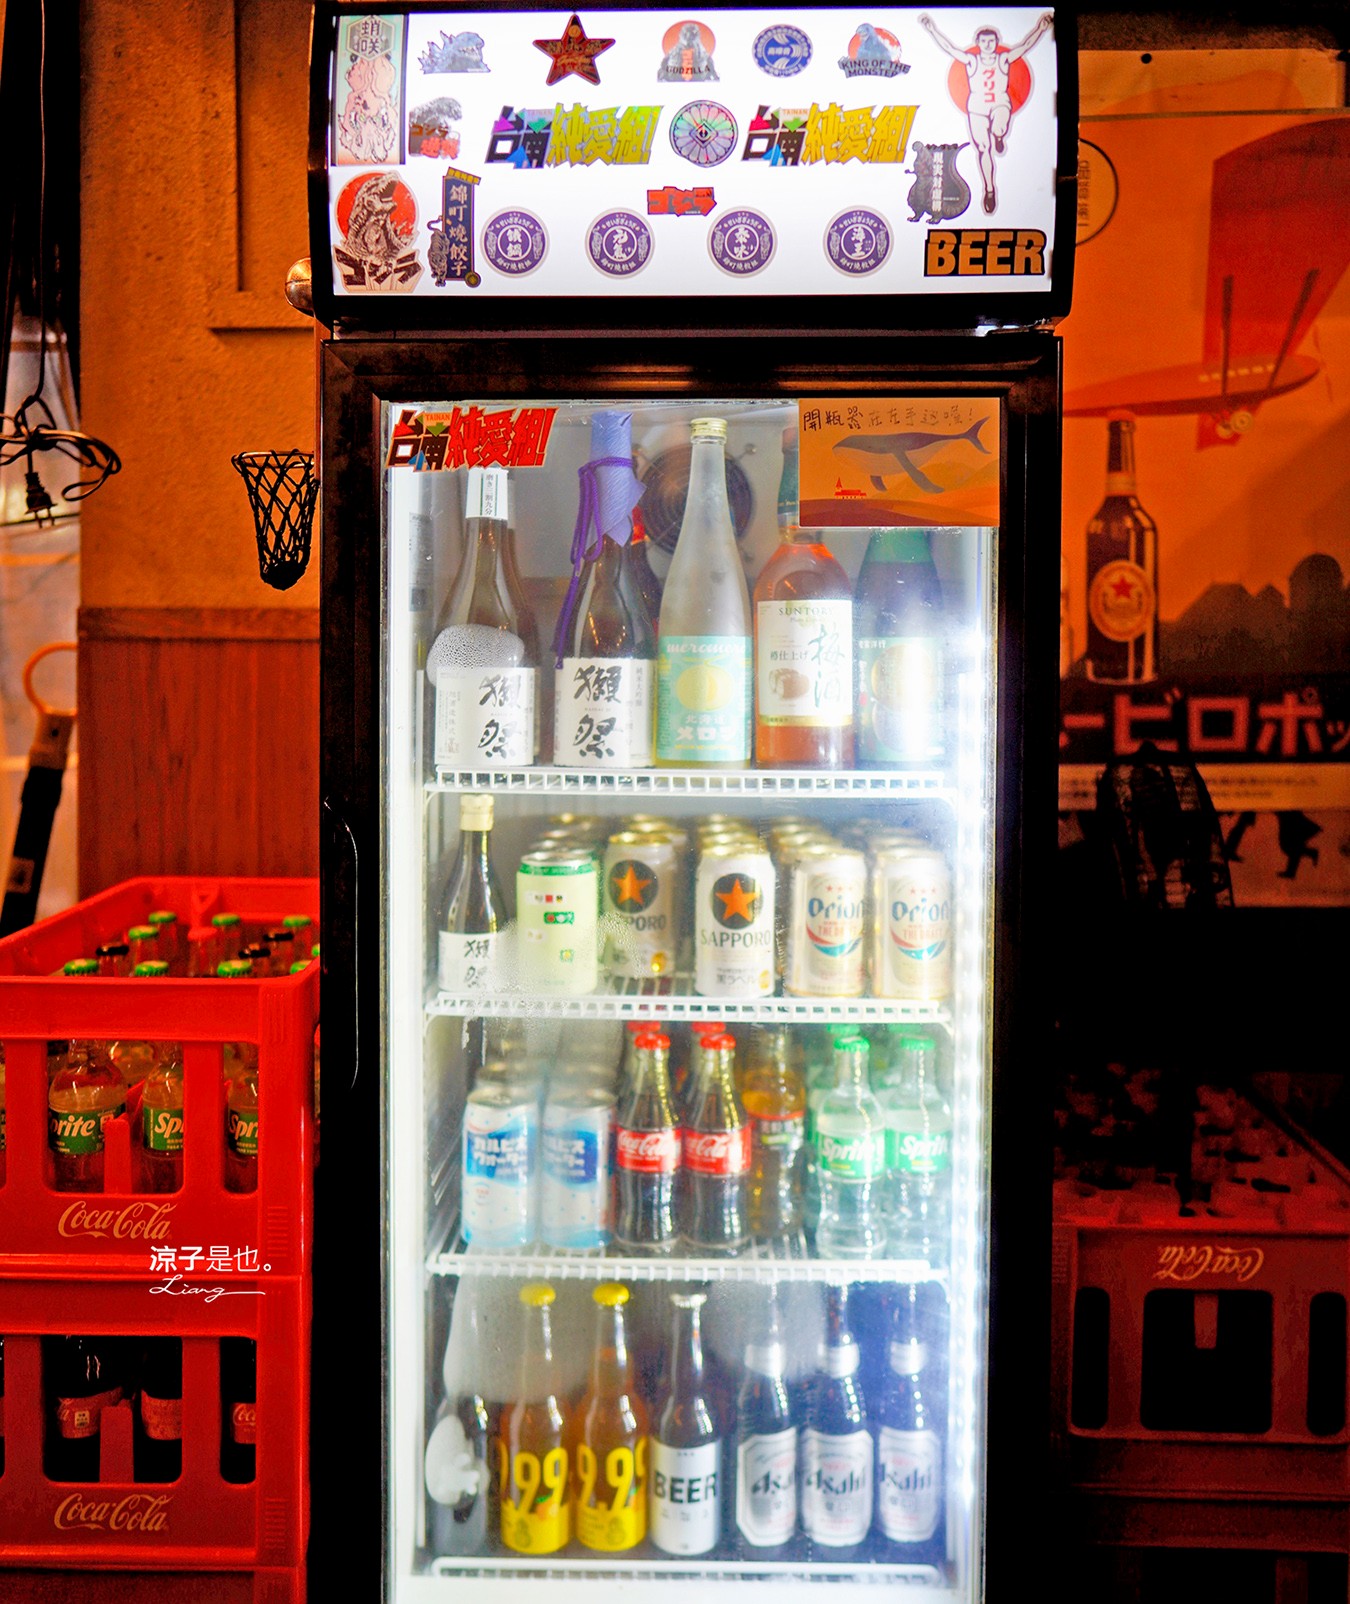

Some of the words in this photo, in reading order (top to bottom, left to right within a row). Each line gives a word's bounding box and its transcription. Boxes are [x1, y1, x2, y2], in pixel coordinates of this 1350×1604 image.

[665, 65, 711, 75] GODZILLA
[871, 59, 885, 68] OF
[982, 68, 996, 103] グリコ
[926, 231, 1046, 275] BEER
[700, 929, 771, 948] SAPPORO
[655, 1470, 718, 1504] BEER
